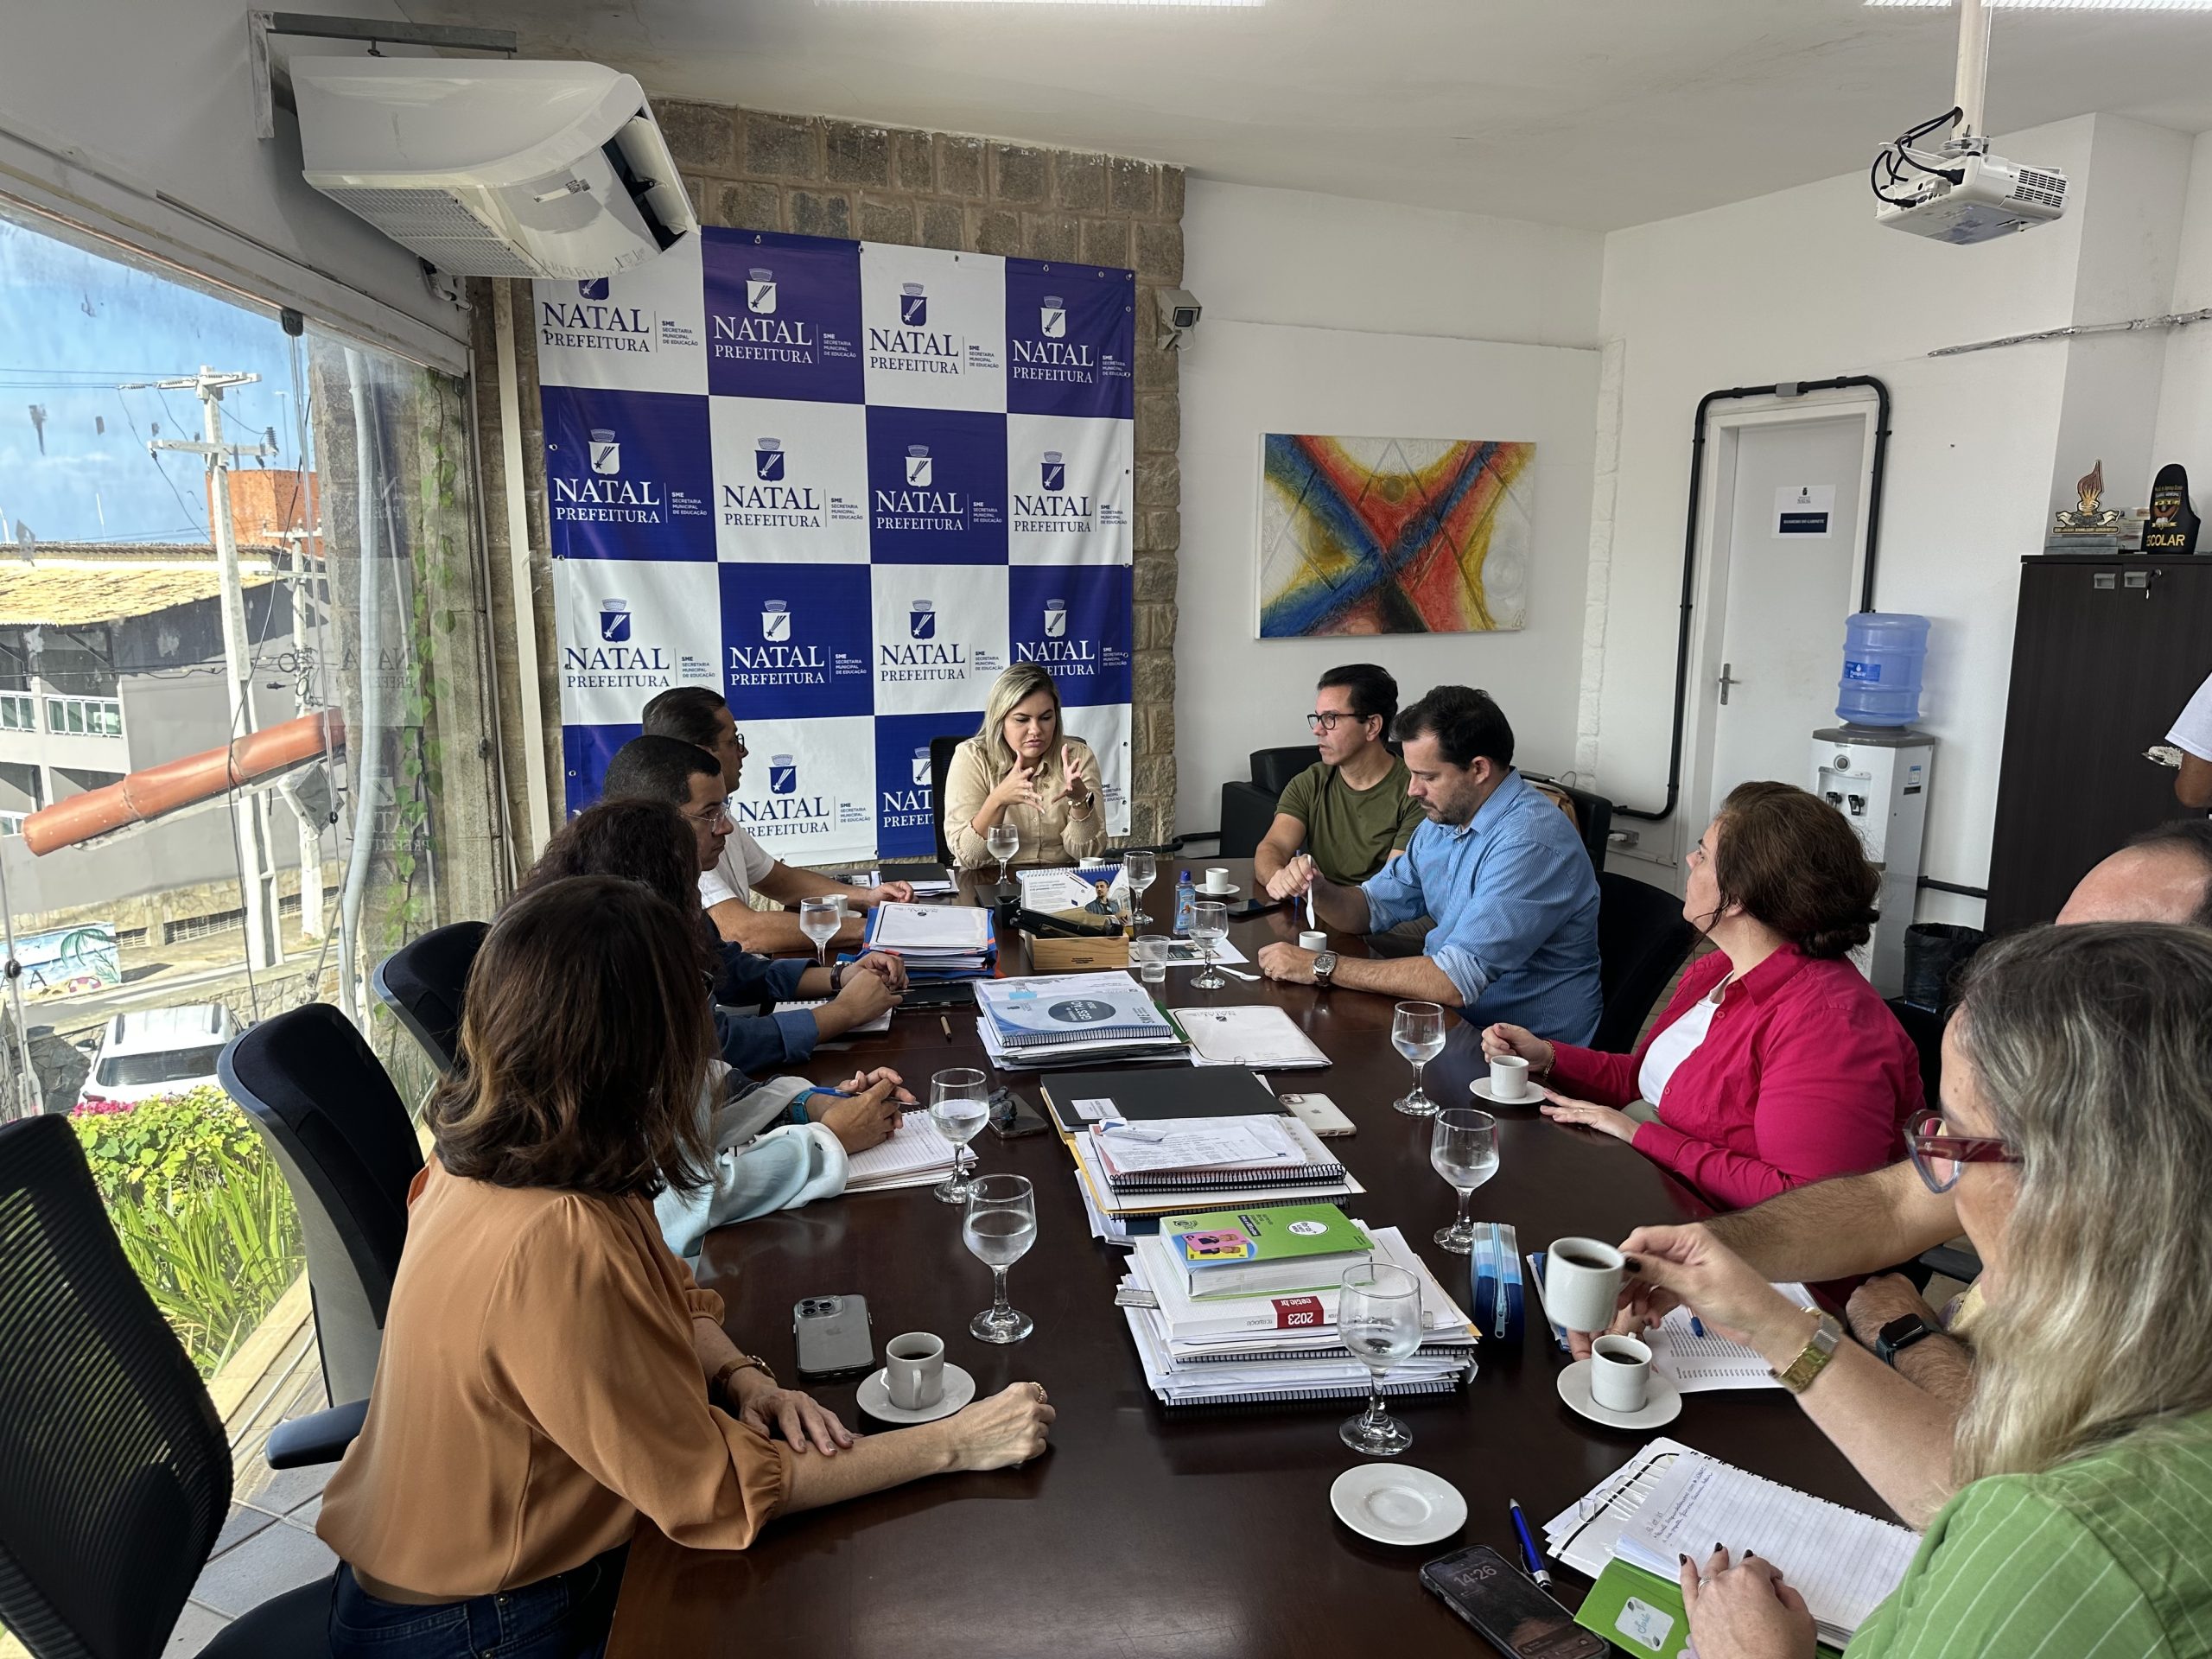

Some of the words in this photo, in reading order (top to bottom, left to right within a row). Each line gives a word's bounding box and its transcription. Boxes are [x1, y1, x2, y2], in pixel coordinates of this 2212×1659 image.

[542, 302, 650, 334] NATAL
[713, 315, 812, 346] NATAL
[543, 332, 651, 353] PREFEITURA
[868, 327, 959, 357] NATAL
[715, 345, 813, 364] PREFEITURA
[1012, 340, 1094, 366] NATAL
[870, 357, 959, 375] PREFEITURA
[1013, 366, 1093, 384] PREFEITURA
[553, 478, 660, 505] NATAL
[722, 485, 820, 511] NATAL
[874, 490, 963, 514] NATAL
[1014, 494, 1092, 517] NATAL
[555, 507, 660, 524] PREFEITURA
[724, 513, 821, 528] PREFEITURA
[876, 517, 963, 531] PREFEITURA
[1014, 520, 1091, 533] PREFEITURA
[564, 647, 671, 671] NATAL
[729, 645, 824, 669] NATAL
[880, 644, 965, 665] NATAL
[1016, 640, 1095, 662] NATAL
[731, 672, 825, 686] PREFEITURA
[880, 669, 965, 682] PREFEITURA
[1041, 664, 1095, 676] EITURA
[567, 675, 670, 689] PREFEITURA
[737, 797, 830, 823] NATAL
[883, 789, 932, 812] NAT
[742, 822, 830, 837] REFEITURA
[883, 813, 934, 828] PREFEI
[1281, 1298, 1312, 1306] cetic.br
[1287, 1313, 1313, 1325] 2023
[1453, 1566, 1497, 1586] 14:26
